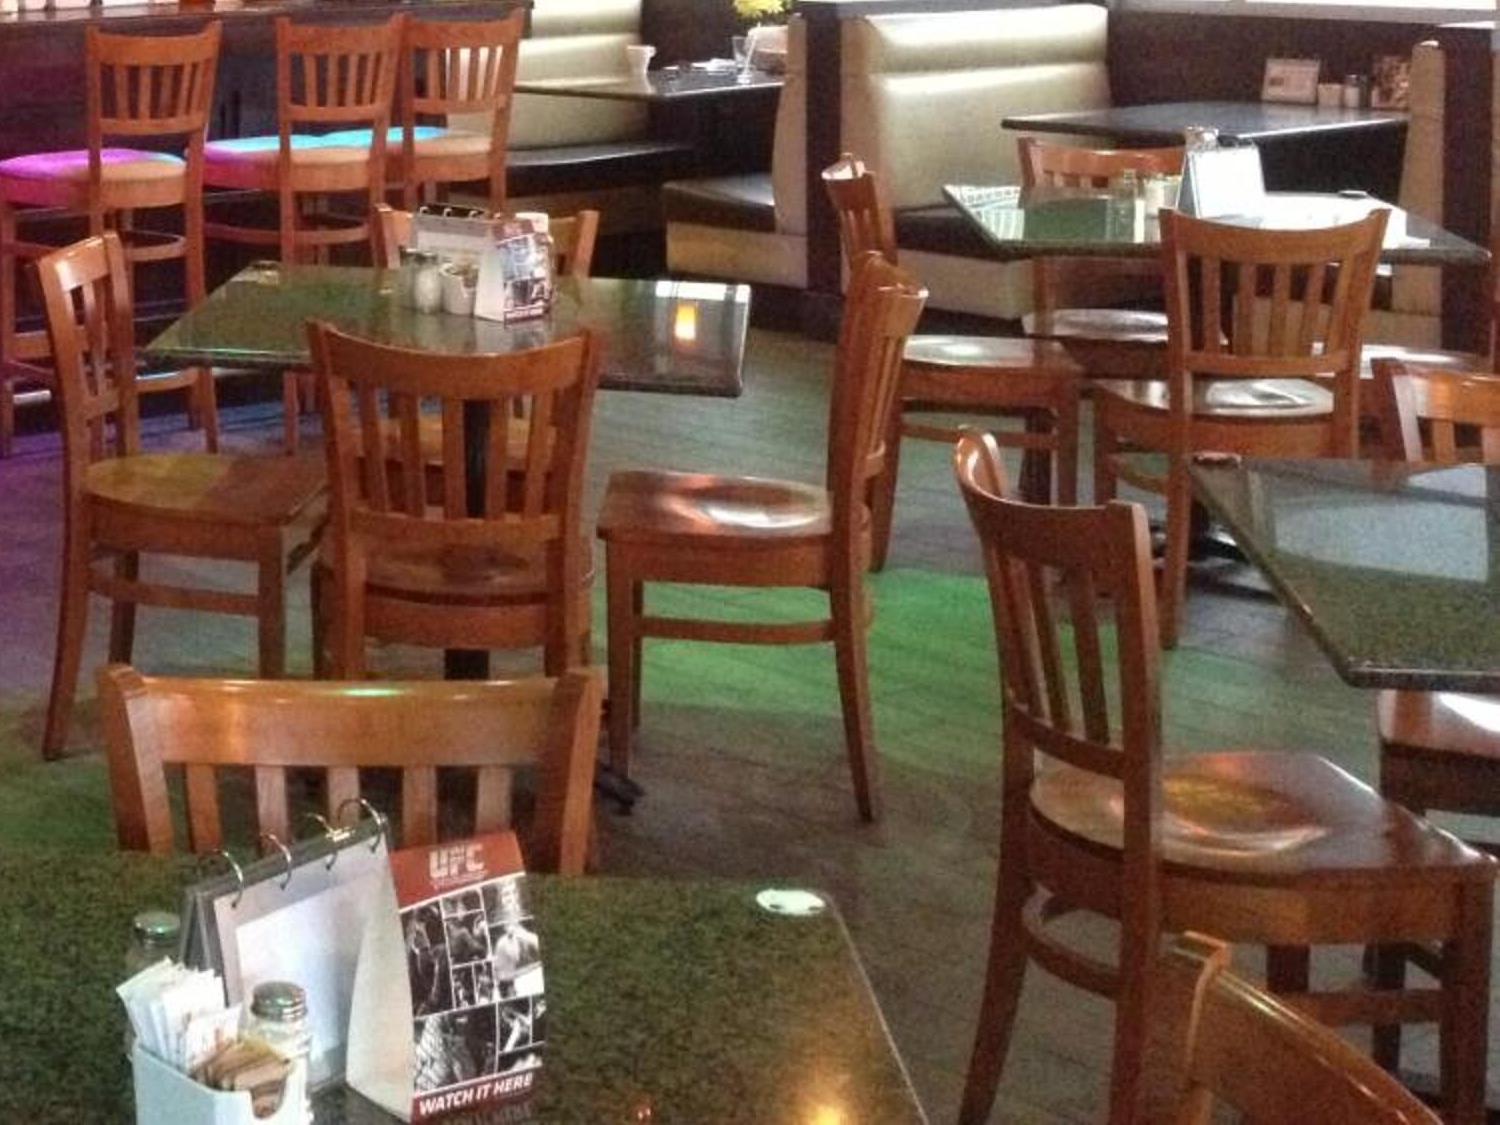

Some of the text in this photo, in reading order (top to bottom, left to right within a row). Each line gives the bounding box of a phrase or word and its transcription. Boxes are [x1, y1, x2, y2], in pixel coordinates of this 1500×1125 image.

[430, 843, 485, 878] UFC
[419, 1072, 533, 1115] WATCH IT HERE
